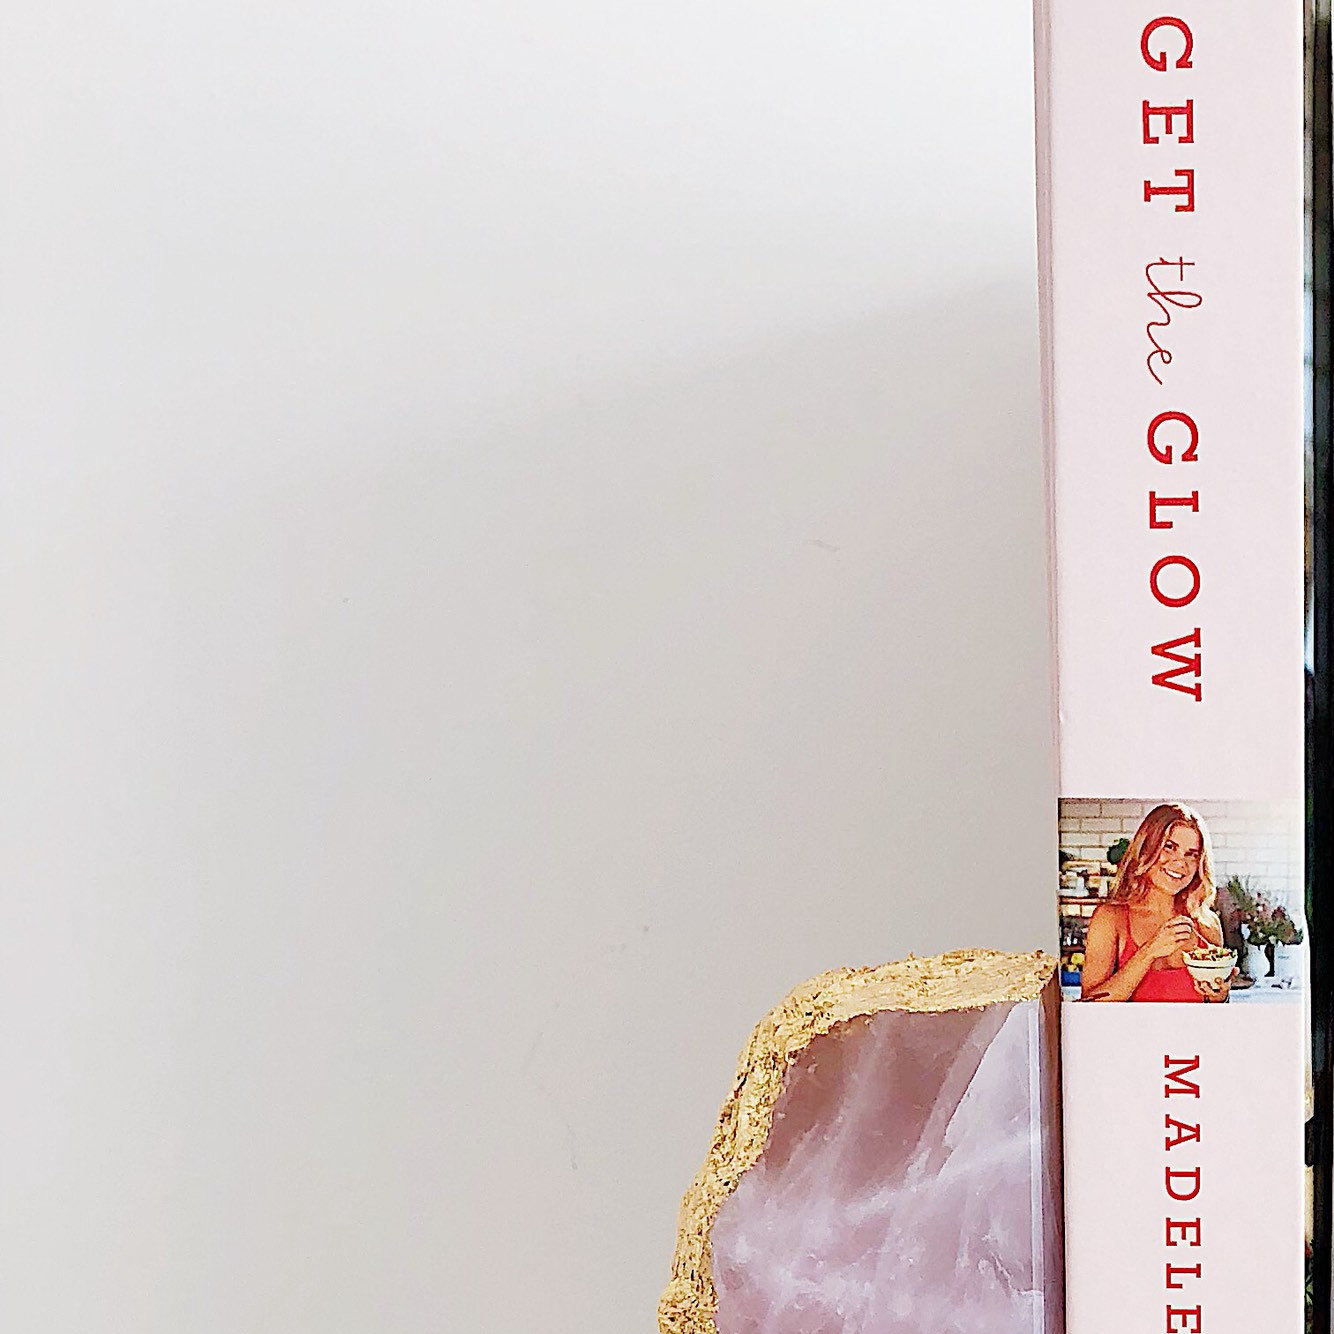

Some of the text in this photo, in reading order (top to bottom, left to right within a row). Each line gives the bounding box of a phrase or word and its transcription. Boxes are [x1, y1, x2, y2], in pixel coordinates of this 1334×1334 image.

[1141, 17, 1202, 702] GET the GLOW
